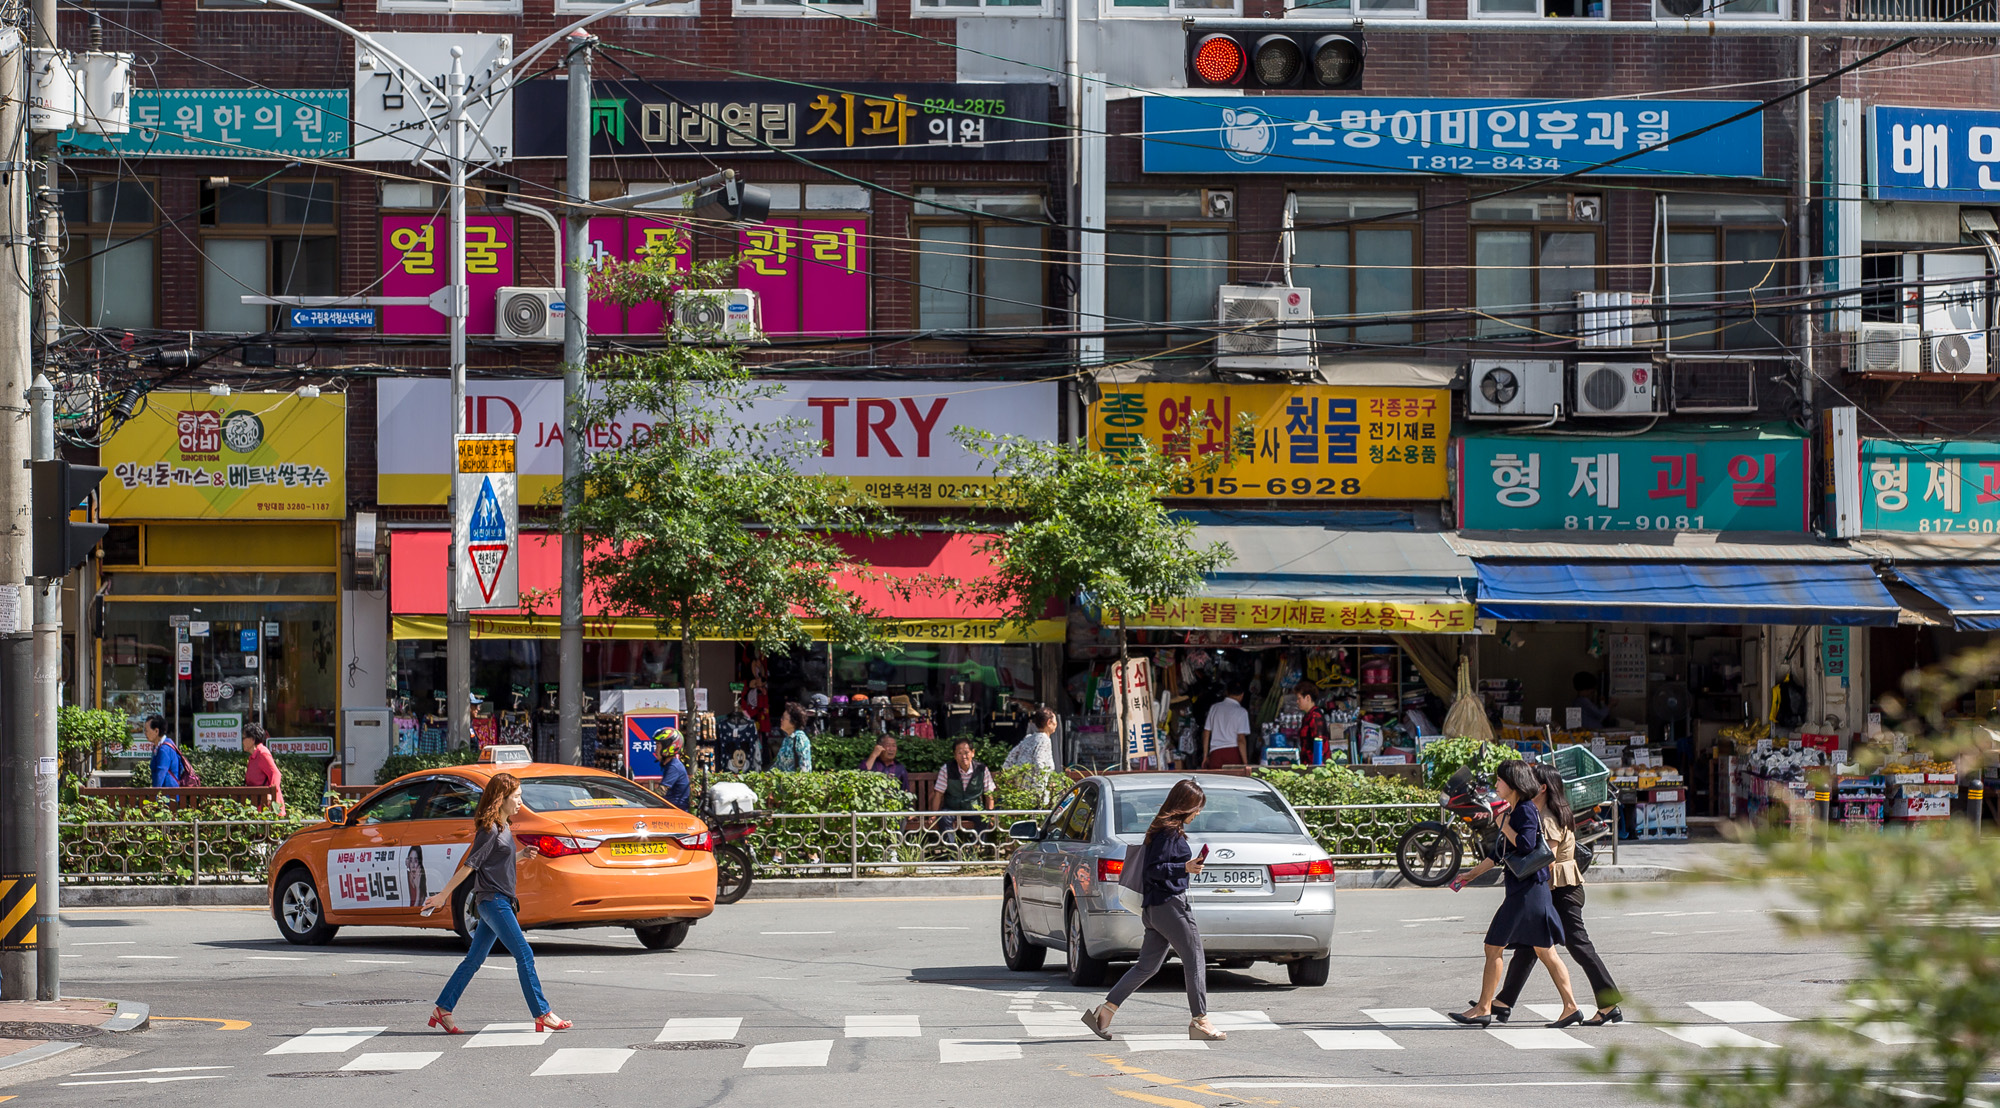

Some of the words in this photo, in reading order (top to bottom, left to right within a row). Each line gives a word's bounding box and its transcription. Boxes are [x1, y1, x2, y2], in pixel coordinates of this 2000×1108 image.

[924, 98, 1005, 115] 824-2875
[58, 104, 322, 143] 동원한의원
[641, 102, 797, 147] 미래열린
[806, 93, 918, 147] 치과
[328, 132, 342, 143] 2F
[928, 118, 985, 148] 의원
[1292, 109, 1630, 149] 소망이비인후과
[1636, 109, 1670, 151] 의원
[1406, 155, 1561, 171] T.812-8434
[390, 224, 507, 274] 얼굴
[743, 226, 858, 276] 관리
[310, 312, 373, 325] 구립흑석청소년독서실
[1288, 307, 1299, 315] LG
[1633, 386, 1646, 394] LG
[1369, 398, 1437, 417] 각종공구
[807, 397, 948, 458] TRY
[1159, 396, 1231, 465] 열쇠
[1286, 396, 1361, 464] 철물
[1369, 421, 1437, 441] 전기재료
[180, 433, 218, 452] 아비
[458, 444, 515, 457] 어린이보호구역
[1368, 444, 1437, 464] 청소용품
[463, 459, 489, 470] SCHOOL
[493, 459, 512, 469] ZONE
[114, 461, 213, 489] 일식돈까스
[212, 471, 225, 487] &
[227, 462, 331, 489] 베트남쌀국수
[1490, 453, 1620, 509] 형제
[1648, 453, 1777, 509] 과일
[1179, 477, 1361, 495] 815-6928
[1871, 457, 1962, 513] 형제
[1564, 515, 1705, 530] 817-9081
[472, 528, 503, 538] 어린이보호
[478, 552, 498, 565] 천천히
[481, 565, 496, 575] SLOW
[1200, 602, 1237, 623] 철물
[1251, 604, 1327, 626] 전기재료
[1339, 606, 1417, 628] 청소용구
[1427, 609, 1465, 627] 수도
[476, 618, 495, 639] JD
[498, 626, 524, 634] JAMES
[525, 625, 548, 634] DEAN
[906, 624, 997, 638] 02-821-2115
[290, 743, 303, 752] 자리
[304, 743, 329, 752] 있습니다
[632, 741, 656, 753] 주차
[504, 752, 521, 761] TAXI
[641, 842, 665, 854] 3323
[1223, 871, 1256, 884] 5085
[338, 871, 400, 902] 네모네모
